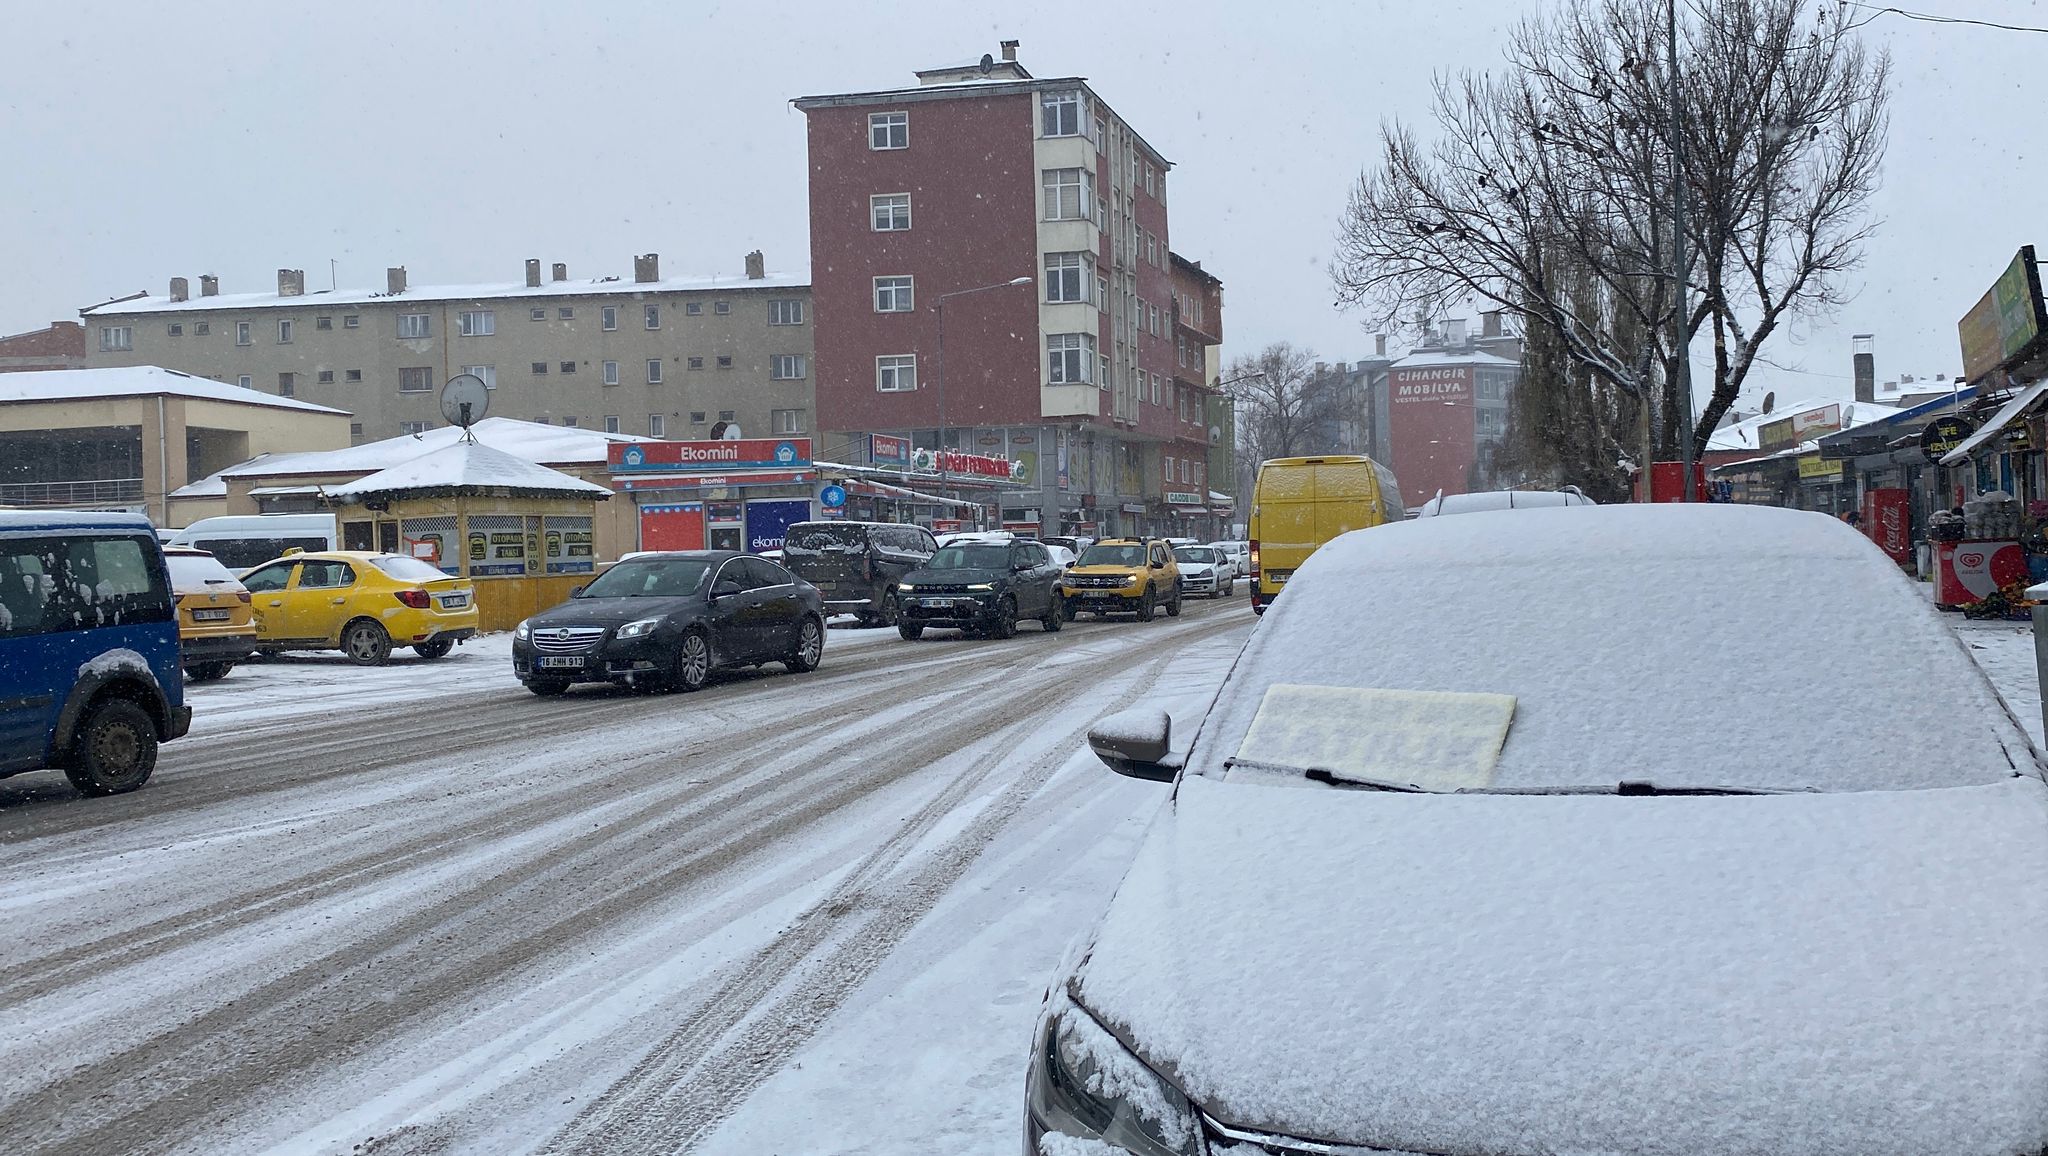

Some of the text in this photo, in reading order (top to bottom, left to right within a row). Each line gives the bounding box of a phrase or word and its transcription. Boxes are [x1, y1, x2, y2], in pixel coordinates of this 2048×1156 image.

[680, 445, 738, 460] Ekomini
[876, 440, 898, 456] Ekomini
[700, 477, 726, 485] Ekomini
[541, 657, 550, 666] 16
[568, 657, 583, 667] 913
